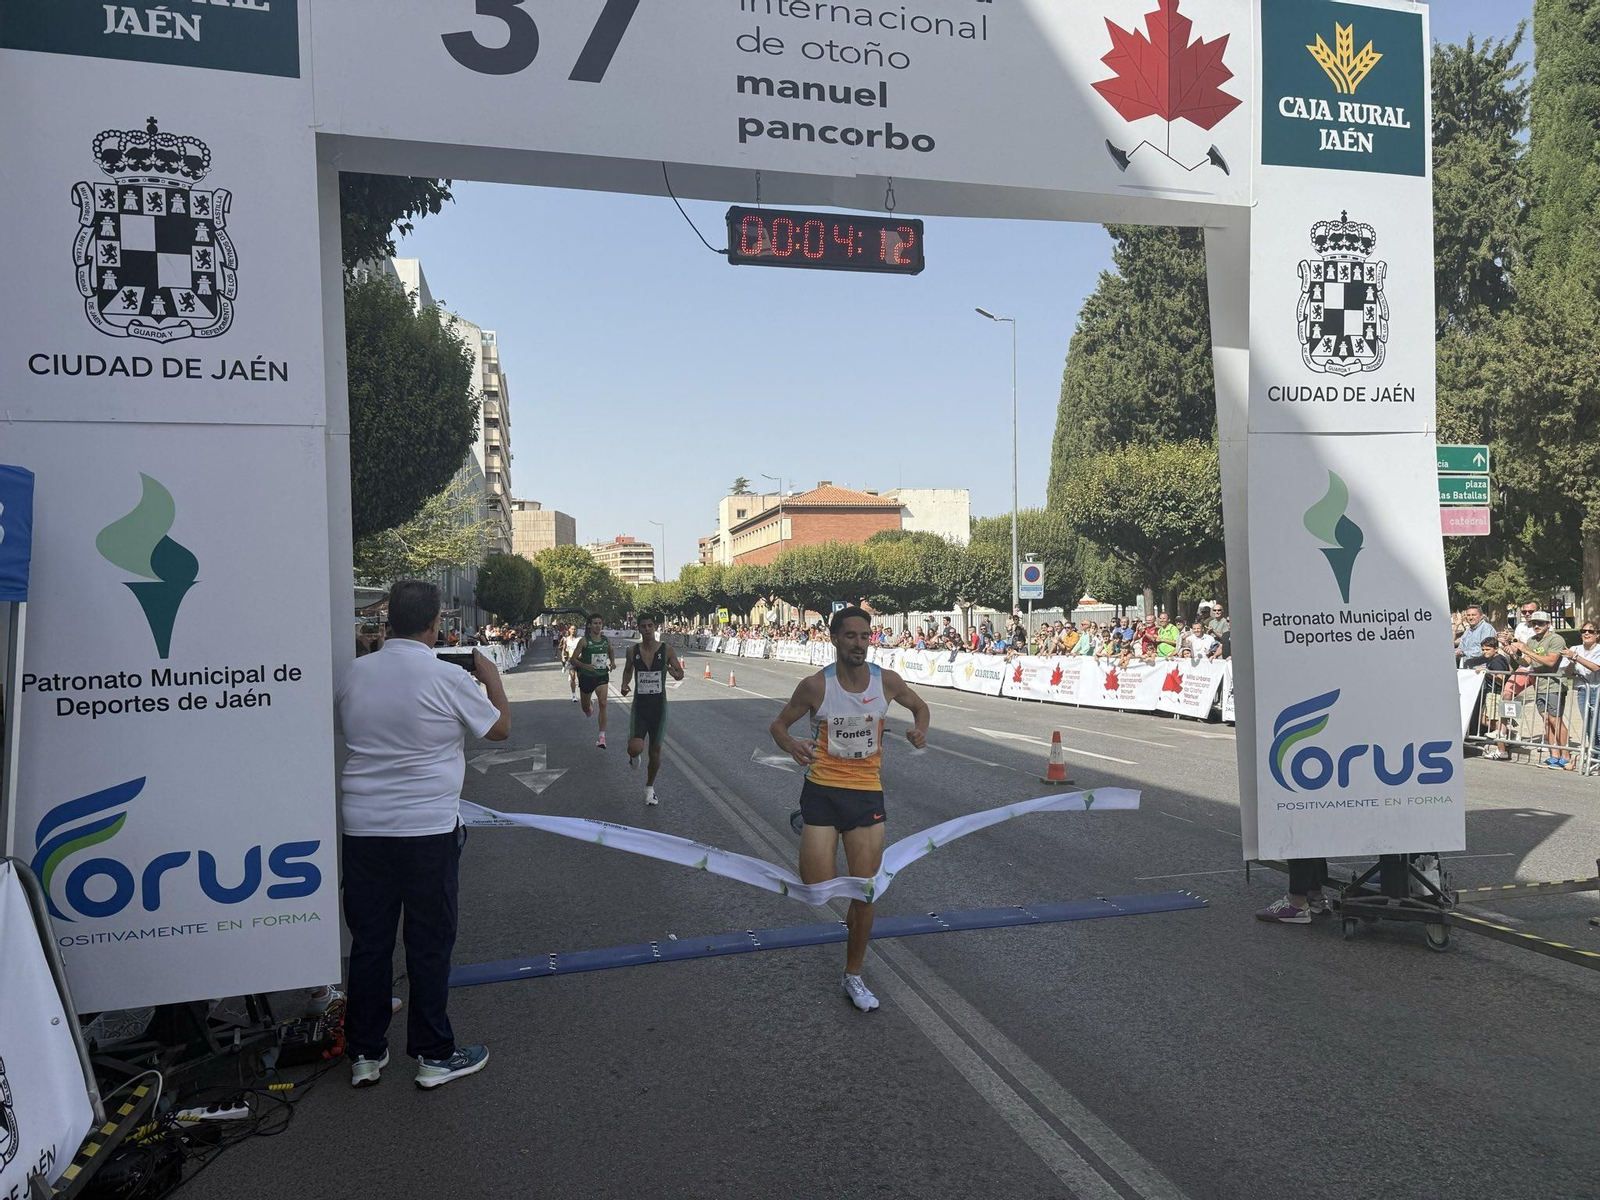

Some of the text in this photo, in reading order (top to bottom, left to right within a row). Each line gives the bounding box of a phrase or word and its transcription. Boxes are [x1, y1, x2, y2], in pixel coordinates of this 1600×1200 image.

[103, 4, 201, 41] JAÉN
[736, 26, 911, 70] de otoño
[737, 74, 888, 108] manuel
[1279, 96, 1411, 129] CAJA RURAL
[738, 117, 936, 153] pancorbo
[1319, 128, 1374, 153] JAÉN
[215, 195, 224, 225] CASTILLA
[133, 327, 167, 339] GUARDA
[28, 354, 288, 382] CIUDAD DE JAÉN
[1268, 383, 1415, 402] CIUDAD DE JAÉN
[1453, 491, 1487, 499] Batallas
[1465, 481, 1487, 489] plaza
[1450, 516, 1487, 526] catedral
[1262, 609, 1432, 628] Patronato Municipal de
[1284, 625, 1415, 646] Deportes de Jaén
[22, 663, 303, 692] Patronato Municipal de
[56, 687, 272, 719] Deportes de Jaén
[833, 717, 845, 726] 37
[836, 729, 871, 739] Fontes
[867, 738, 873, 748] 5
[1268, 688, 1453, 793] Forus
[1276, 795, 1453, 811] POSITIVAMENTE EN FORMA
[30, 776, 322, 924] Forus
[56, 912, 321, 948] OSITIVAMENTE EN FORMA
